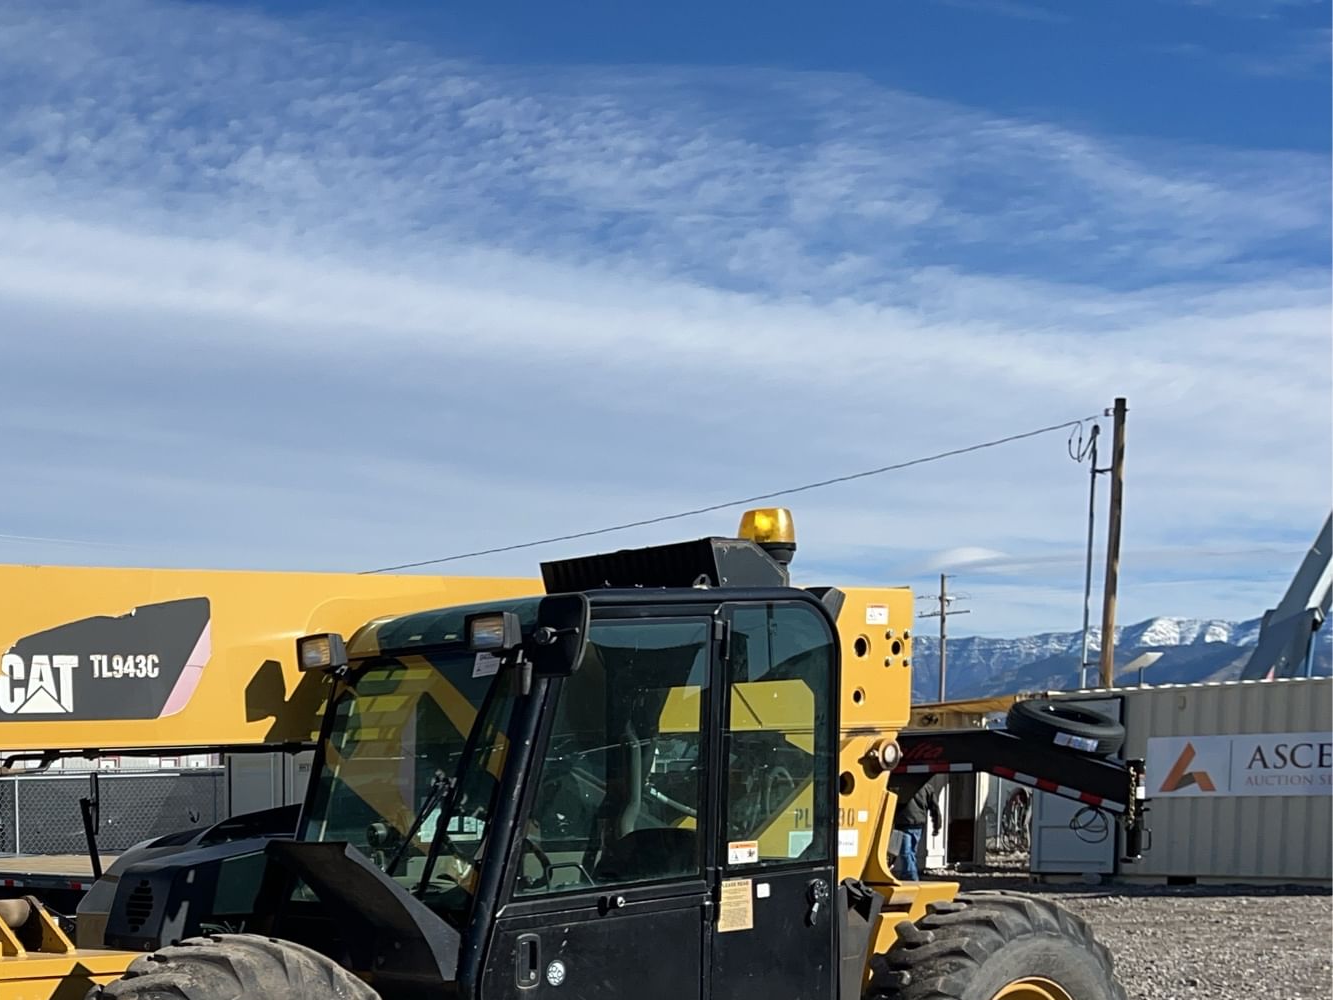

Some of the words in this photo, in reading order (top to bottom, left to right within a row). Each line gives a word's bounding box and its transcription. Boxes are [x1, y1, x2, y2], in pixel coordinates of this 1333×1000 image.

[89, 654, 160, 679] TL943C
[1245, 743, 1333, 771] ASCE
[1245, 775, 1315, 786] AUCTION
